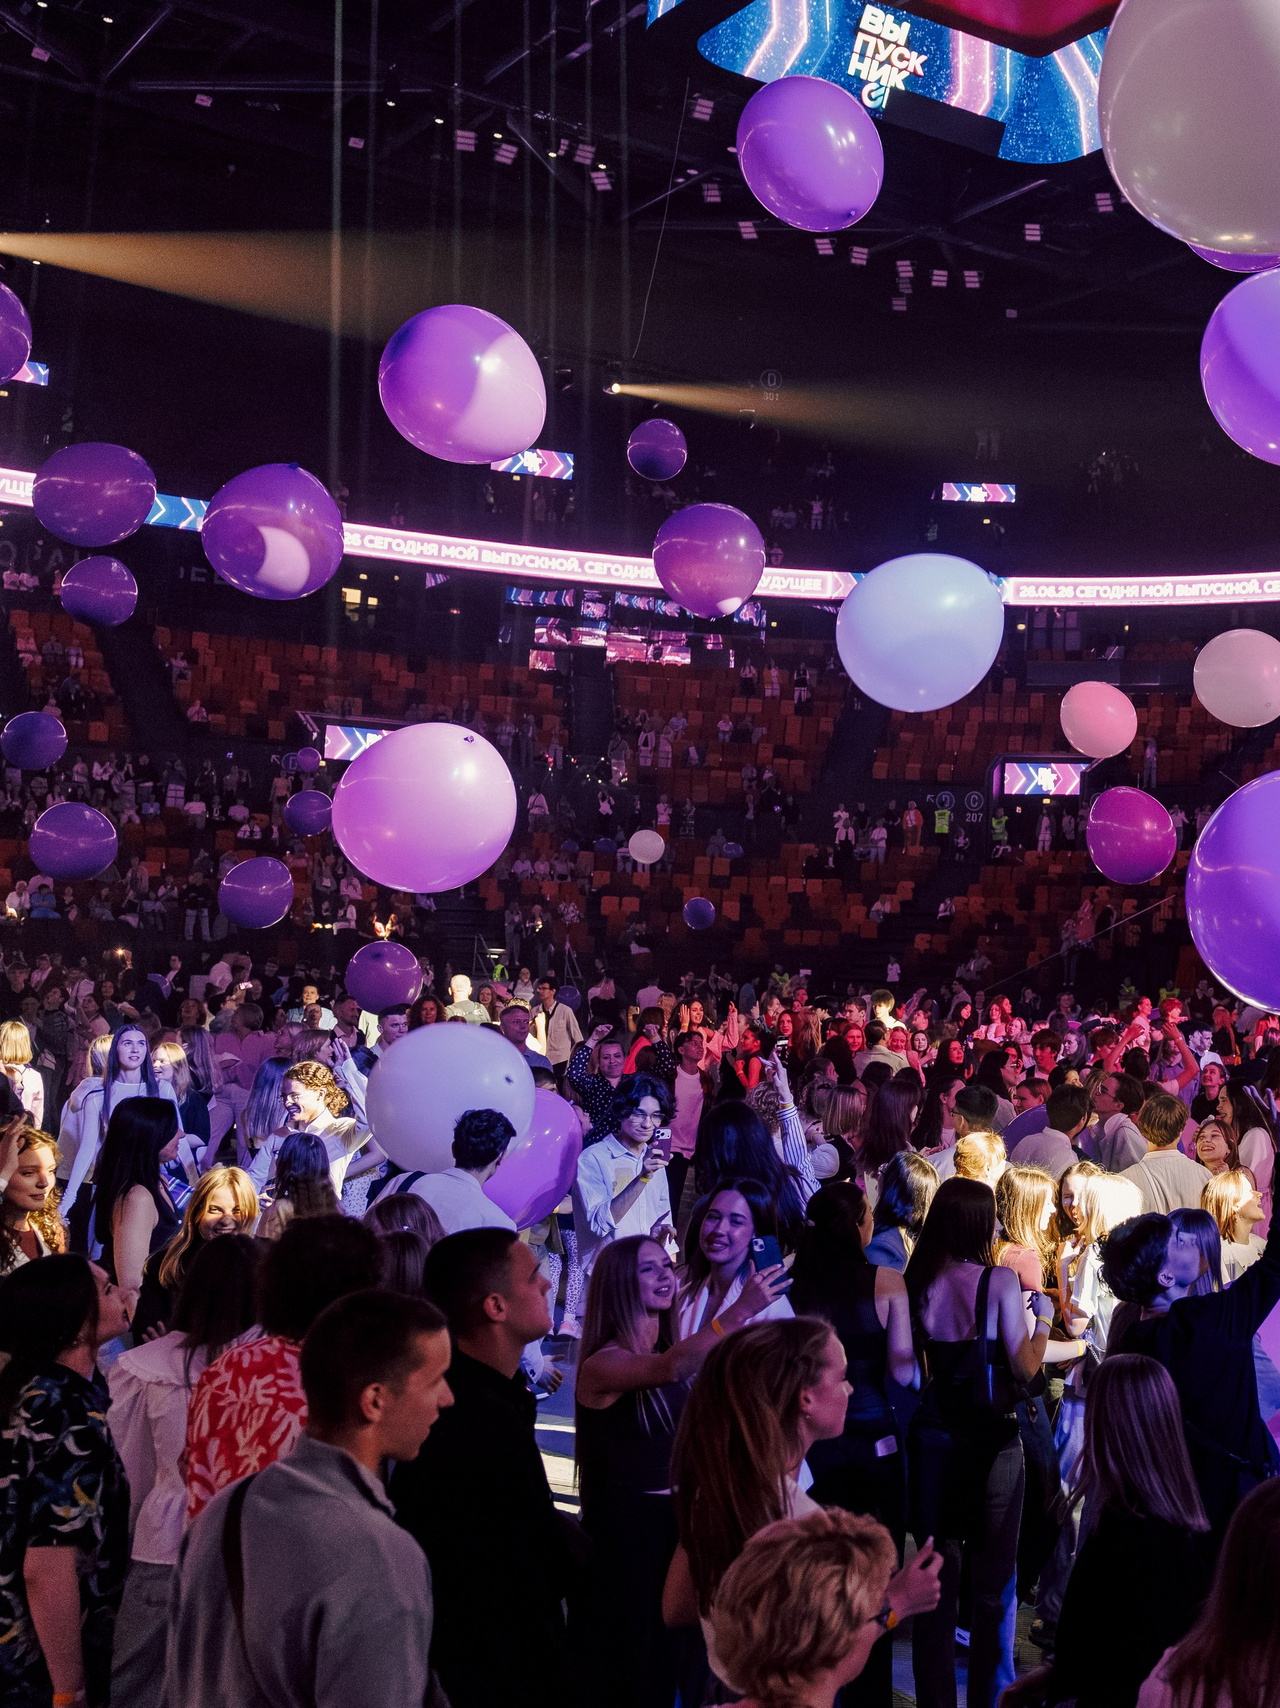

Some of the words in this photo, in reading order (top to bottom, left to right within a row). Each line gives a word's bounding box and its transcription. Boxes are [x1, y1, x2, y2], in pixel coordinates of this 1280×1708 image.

[859, 3, 910, 47] ВЫ
[847, 52, 911, 91] НИК
[853, 31, 929, 77] ПУСК
[363, 534, 439, 557] СЕГОДНЯ
[441, 544, 479, 561] МОЙ
[481, 549, 582, 573] ВЫПУСКНОЙ.
[584, 560, 655, 580] СЕГОДНЯ
[760, 575, 822, 592] УДУЩЕЕ
[1076, 584, 1139, 600] СЕГОДНЯ
[1141, 582, 1173, 598] МОЙ
[1175, 579, 1262, 597] ВЫПУСКНОЙ.
[965, 812, 983, 823] 207
